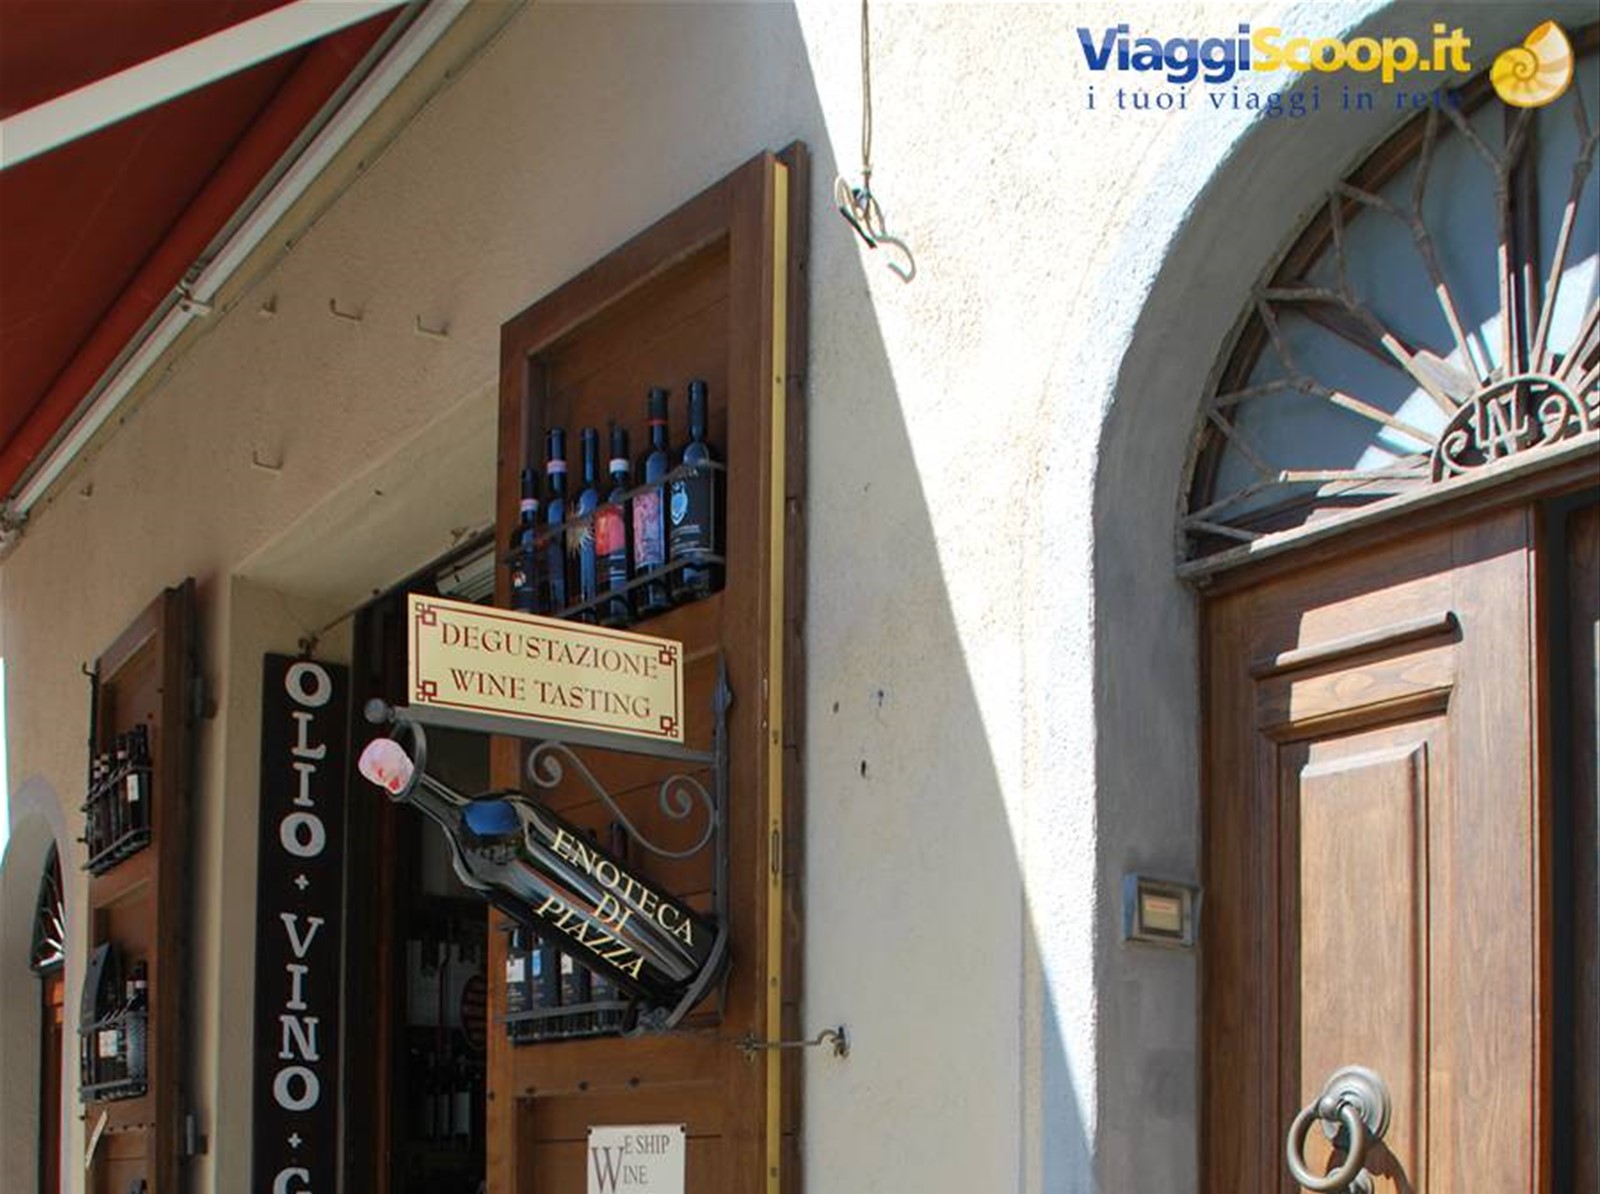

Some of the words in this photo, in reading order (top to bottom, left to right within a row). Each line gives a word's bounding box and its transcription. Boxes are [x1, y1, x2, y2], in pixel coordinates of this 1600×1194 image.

[441, 622, 658, 679] DEGUSTAZIONE
[450, 668, 525, 701] WINE
[534, 680, 651, 718] TASTING
[280, 661, 332, 858] OLIO
[551, 829, 696, 947] ENOTECA
[593, 891, 634, 933] DI
[537, 896, 644, 980] PIAZZA
[273, 912, 325, 1111] VINO
[636, 1134, 670, 1154] SHIP
